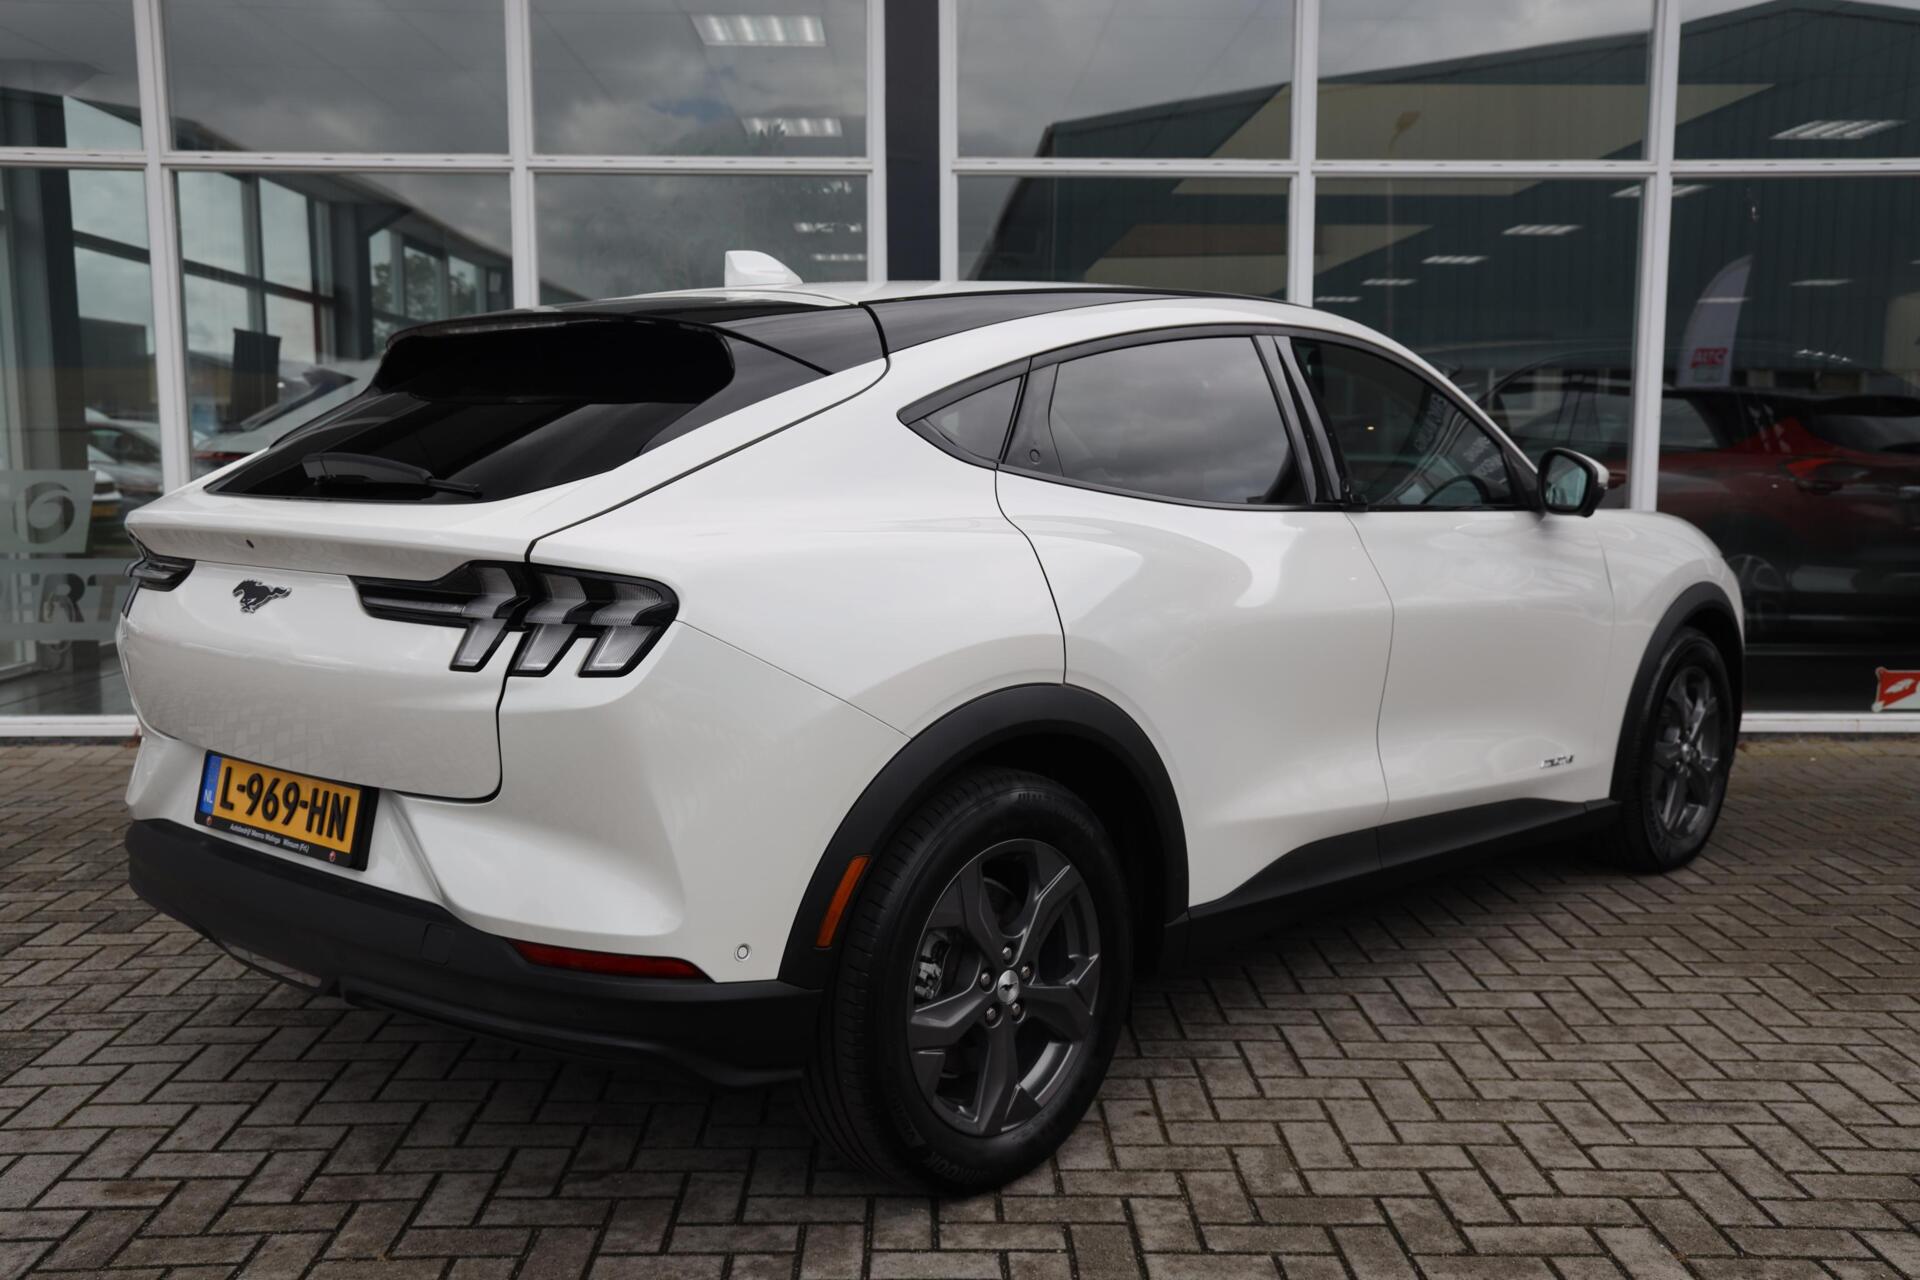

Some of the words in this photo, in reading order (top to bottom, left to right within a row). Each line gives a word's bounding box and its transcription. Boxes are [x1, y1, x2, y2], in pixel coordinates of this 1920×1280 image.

[0, 573, 129, 623] ERT
[203, 788, 213, 804] NL
[219, 766, 351, 842] L-969-HN
